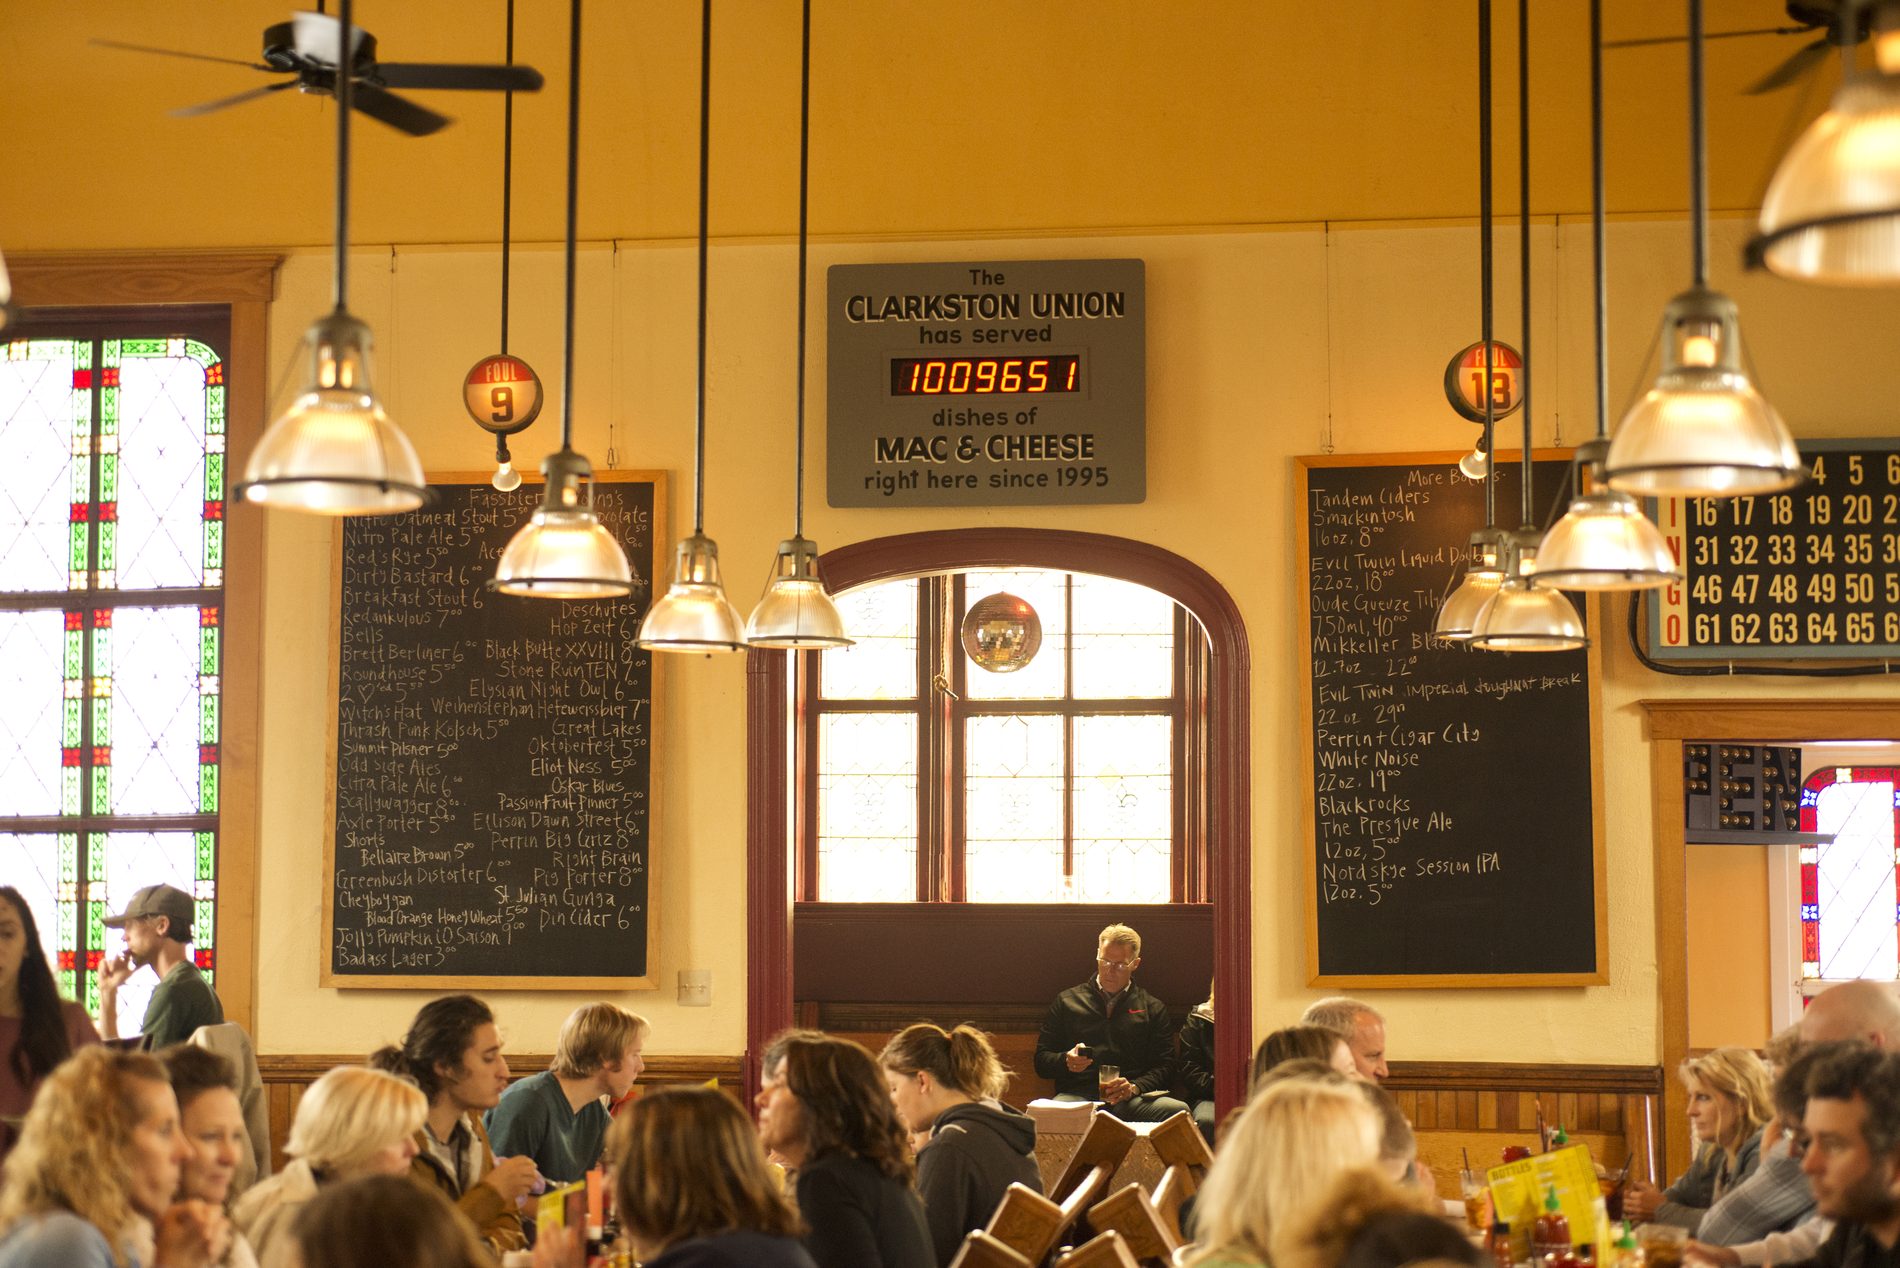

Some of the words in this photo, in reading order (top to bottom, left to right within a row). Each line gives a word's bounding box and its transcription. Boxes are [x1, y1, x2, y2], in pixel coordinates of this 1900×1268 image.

[968, 268, 1006, 286] The
[844, 292, 1020, 325] CLARKSTON
[1029, 290, 1126, 320] UNION
[918, 326, 963, 345] has
[971, 323, 1052, 344] served
[485, 362, 518, 383] FOUL
[1471, 372, 1511, 410] 13
[490, 386, 514, 423] 9
[931, 407, 1009, 427] dishes
[1014, 406, 1039, 426] of
[874, 434, 948, 465] MAC
[954, 434, 981, 464] &
[984, 432, 1095, 463] CHEESE
[863, 469, 919, 496] right
[926, 469, 979, 489] here
[988, 468, 1050, 488] since
[1056, 466, 1109, 488] 1995
[1407, 469, 1444, 487] More
[1811, 455, 1827, 486] 4
[1849, 455, 1864, 486] 5
[1887, 454, 1900, 485] 6
[1310, 487, 1374, 512] Tandem
[1379, 485, 1431, 505] Ciders
[395, 508, 456, 527] Oatmeal
[461, 508, 499, 527] Stout
[1312, 505, 1416, 526] Smackintosh
[1693, 498, 1718, 527] 16
[1730, 496, 1755, 526] 17
[1768, 495, 1794, 525] 18
[1806, 495, 1831, 525] 19
[1843, 494, 1872, 524] 20
[345, 530, 385, 547] Nitro
[391, 526, 423, 546] Pale
[428, 527, 454, 546] Ale
[391, 547, 422, 567] Rye
[1311, 554, 1348, 572] Evil
[1354, 553, 1396, 570] Twin
[1401, 547, 1444, 568] Liquid
[1695, 536, 1719, 565] 31
[1729, 535, 1759, 565] 32
[1768, 535, 1797, 565] 33
[1806, 534, 1836, 564] 34
[1844, 534, 1873, 564] 35
[345, 566, 387, 586] Dirty
[390, 566, 454, 586] Bastard
[343, 586, 421, 607] Breakfast
[427, 587, 468, 607] Stout
[1692, 575, 1723, 605] 46
[1731, 574, 1760, 604] 47
[1768, 574, 1798, 604] 48
[1806, 573, 1837, 603] 49
[1845, 573, 1874, 603] 50
[561, 600, 638, 619] Deschutes
[1312, 593, 1350, 613] Oude
[343, 605, 432, 627] Redankulous
[551, 617, 578, 637] Hop
[582, 618, 615, 637] Zeit
[343, 625, 384, 644] Bells
[1695, 613, 1721, 644] 61
[1730, 613, 1761, 644] 62
[1769, 613, 1799, 644] 63
[1807, 612, 1838, 643] 64
[1846, 612, 1875, 643] 65
[342, 643, 385, 664] Brett
[388, 642, 451, 660] Berliner
[485, 639, 521, 660] Black
[525, 638, 561, 661] Butte
[565, 640, 614, 661] XXVIII
[1313, 635, 1400, 654] Mikkeller
[1411, 632, 1456, 651] Black
[342, 663, 428, 682] Roundhouse
[496, 660, 544, 678] Stone
[470, 678, 527, 700] Elysian
[530, 679, 570, 698] Night
[579, 679, 608, 700] Owl
[394, 701, 423, 721] Hat
[340, 720, 392, 739] Thrash
[399, 720, 431, 740] Punk
[435, 719, 485, 741] Kolsch
[551, 717, 596, 736] Great
[602, 717, 642, 738] Lakes
[1317, 728, 1372, 748] Perrin
[1389, 725, 1437, 747] Cigar
[1442, 722, 1481, 744] City
[342, 739, 389, 756] Summit
[390, 740, 434, 757] Pilsner
[339, 757, 368, 773] Odd
[409, 757, 441, 776] Ales
[531, 757, 565, 777] Eliot
[567, 756, 602, 775] Ness
[1317, 750, 1369, 770] White
[1374, 750, 1420, 769] Noise
[338, 774, 376, 792] Citra
[380, 775, 409, 794] Pale
[413, 777, 437, 797] Ale
[551, 776, 590, 794] Oskar
[592, 777, 625, 794] Blues
[339, 790, 433, 815] Scallywagger
[578, 793, 619, 812] Pinner
[1319, 794, 1411, 817] Blackrocks
[336, 811, 375, 831] Axle
[377, 813, 425, 832] Porter
[473, 811, 527, 831] Ellison
[530, 811, 570, 829] Dawn
[575, 810, 623, 829] Street
[1320, 818, 1351, 838] The
[1360, 816, 1420, 837] Presque
[1426, 811, 1453, 832] Ale
[491, 831, 538, 851] Perrin
[545, 829, 571, 849] Big
[361, 848, 412, 867] Bellaire
[412, 846, 451, 864] Brown
[552, 849, 598, 868] Right
[601, 850, 642, 868] Brain
[1415, 858, 1470, 877] Session
[1476, 851, 1501, 875] IPA
[336, 868, 412, 889] Greenbush
[417, 863, 484, 885] Distorter
[534, 867, 559, 887] Pig
[567, 867, 617, 888] Porter
[516, 886, 558, 907] Julian
[562, 887, 616, 908] Gunga
[365, 910, 394, 927] Blood
[396, 910, 433, 928] Orange
[438, 907, 468, 926] Honey
[470, 907, 503, 926] Wheat
[539, 908, 565, 933] Din
[570, 907, 612, 927] Cider
[336, 927, 374, 949] Jolly
[377, 927, 433, 948] Pumpkin
[456, 926, 500, 946] Saison
[338, 946, 387, 967] Badass
[391, 947, 433, 968] Lager
